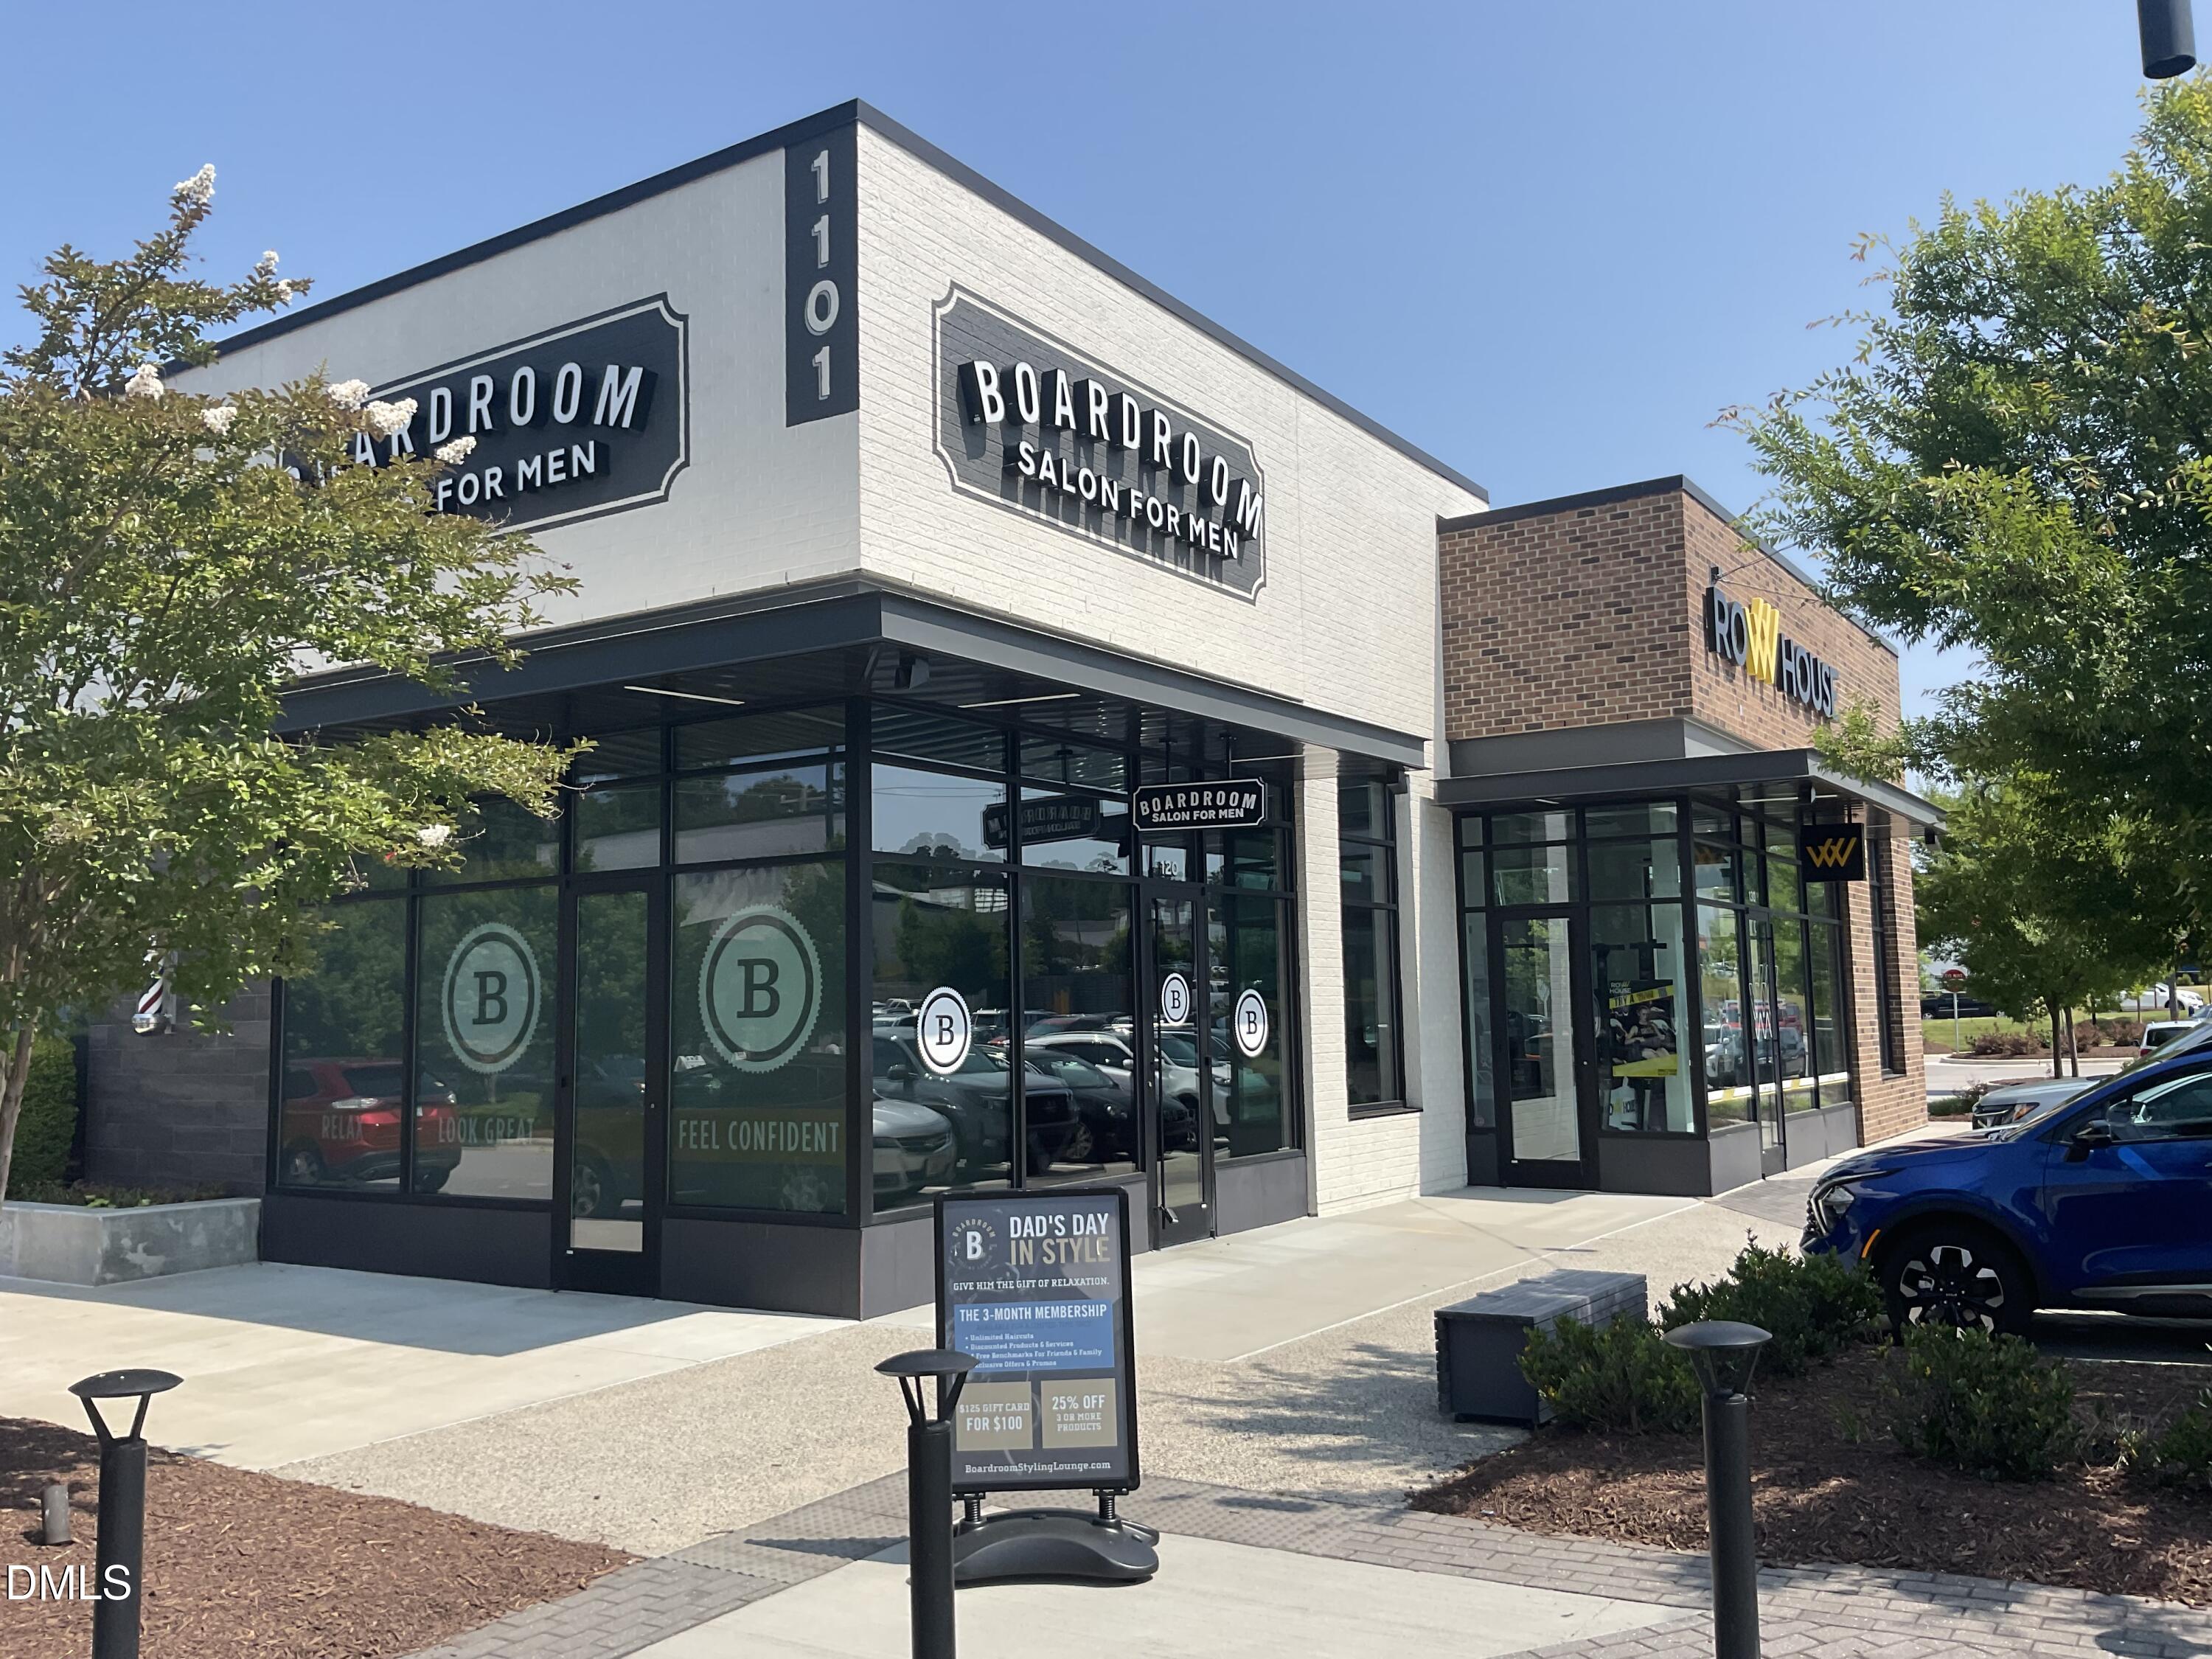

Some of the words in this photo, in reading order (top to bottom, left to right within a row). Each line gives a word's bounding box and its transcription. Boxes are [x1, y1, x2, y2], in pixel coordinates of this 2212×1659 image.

[970, 360, 1263, 540] BOARDROOM
[437, 466, 504, 512] FOR
[518, 440, 596, 492] MEN
[1017, 441, 1119, 512] SALON
[1130, 487, 1180, 537] FOR
[1188, 513, 1238, 560] MEN
[1709, 586, 1780, 685] ROW
[1139, 790, 1257, 816] BOARDROOM
[1152, 810, 1190, 823] SALON
[1193, 810, 1216, 821] FOR
[1218, 808, 1245, 819] MEN
[1160, 860, 1178, 876] 120
[472, 970, 508, 1026] B
[736, 958, 780, 1019] B
[1171, 990, 1181, 1009] B
[936, 1015, 955, 1046] B
[1247, 1010, 1258, 1035] B
[321, 1114, 364, 1140] RELAX
[439, 1116, 478, 1143] LOOK
[484, 1116, 535, 1144] GREAT
[678, 1120, 720, 1150] FEEL
[728, 1120, 840, 1154] CONFIDENT
[952, 1218, 996, 1238] BOARDROOM
[1009, 1214, 1065, 1238] DAD'S
[1072, 1213, 1108, 1236] DAY
[966, 1231, 984, 1260] B
[1010, 1239, 1034, 1266] IN
[1042, 1236, 1110, 1265] STYLE
[953, 1282, 974, 1291] GIVE
[976, 1281, 995, 1290] HIM
[996, 1280, 1015, 1289] THE
[1016, 1279, 1036, 1288] GIFT
[1038, 1279, 1049, 1287] OF
[1051, 1276, 1110, 1287] RELAXATION.
[959, 1309, 980, 1322] THE
[983, 1307, 1032, 1321] 3-MONTH
[1034, 1304, 1107, 1320] MEMBERSHIP
[970, 1333, 1004, 1341] Unlimited
[992, 1351, 1033, 1359] Benchmarks
[1079, 1348, 1102, 1356] Family
[959, 1404, 981, 1413] $125
[983, 1403, 1004, 1413] GIFT
[1005, 1402, 1030, 1412] CARD
[1051, 1395, 1079, 1411] 25%
[1082, 1394, 1106, 1410] OFF
[966, 1416, 990, 1432] FOR
[993, 1415, 1023, 1433] $100
[1057, 1413, 1062, 1422] 3
[1063, 1413, 1075, 1422] OR
[1077, 1412, 1102, 1421] MORE
[1057, 1422, 1102, 1432] PRODUCTS
[964, 1461, 1111, 1474] BoardroomStylingLounge.com
